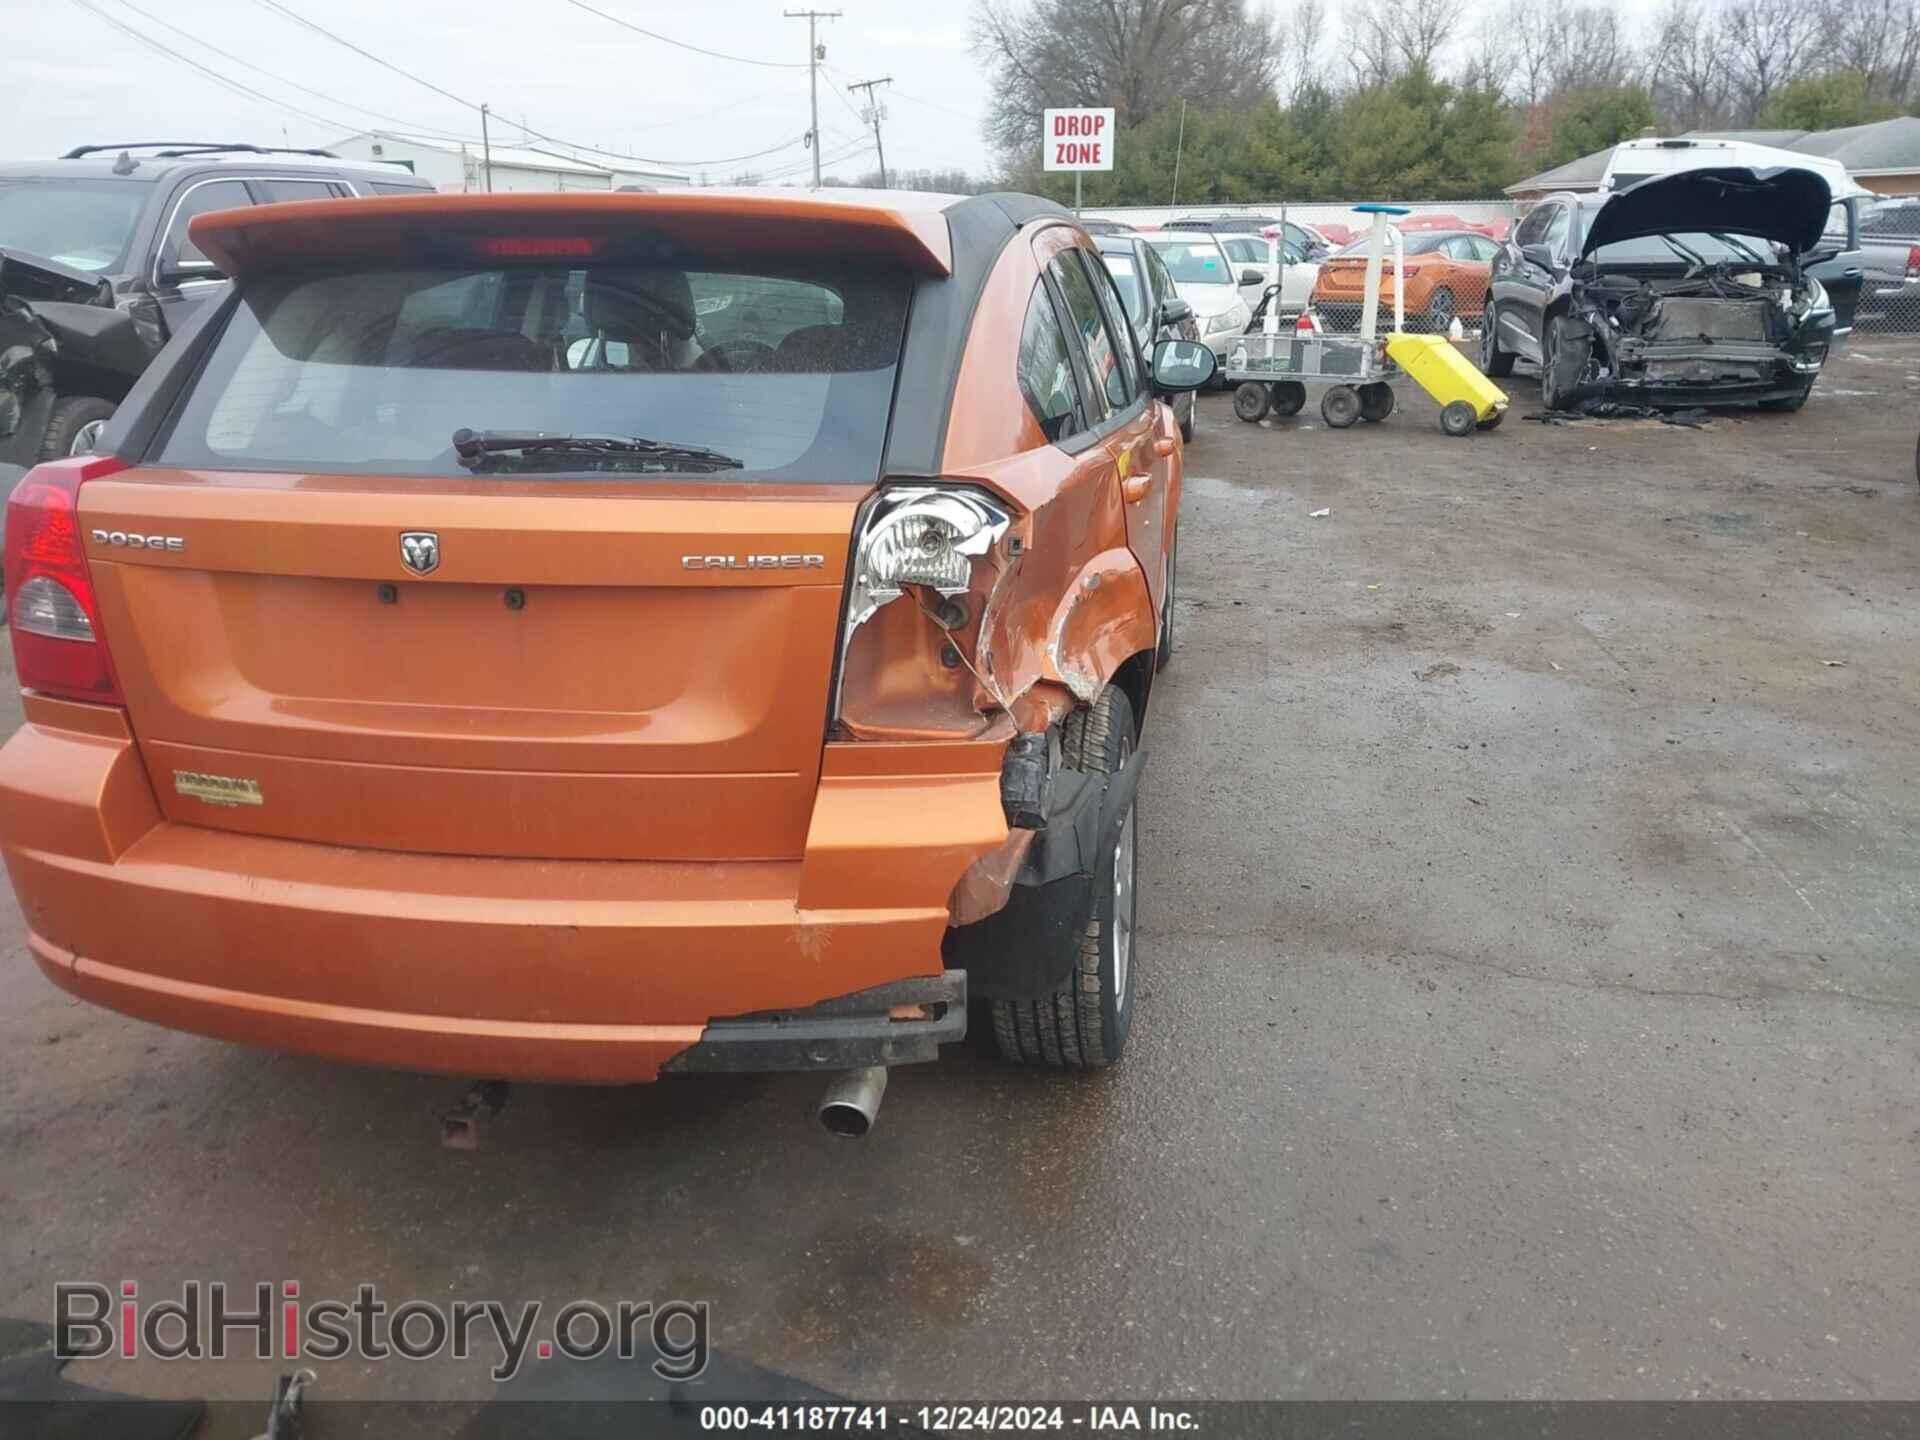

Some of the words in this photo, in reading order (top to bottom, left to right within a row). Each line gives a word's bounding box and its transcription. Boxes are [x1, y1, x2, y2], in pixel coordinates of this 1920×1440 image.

[1054, 115, 1105, 136] DROP
[1056, 143, 1101, 164] ZONE
[92, 529, 184, 552] DODGE
[682, 554, 825, 568] CALIBER
